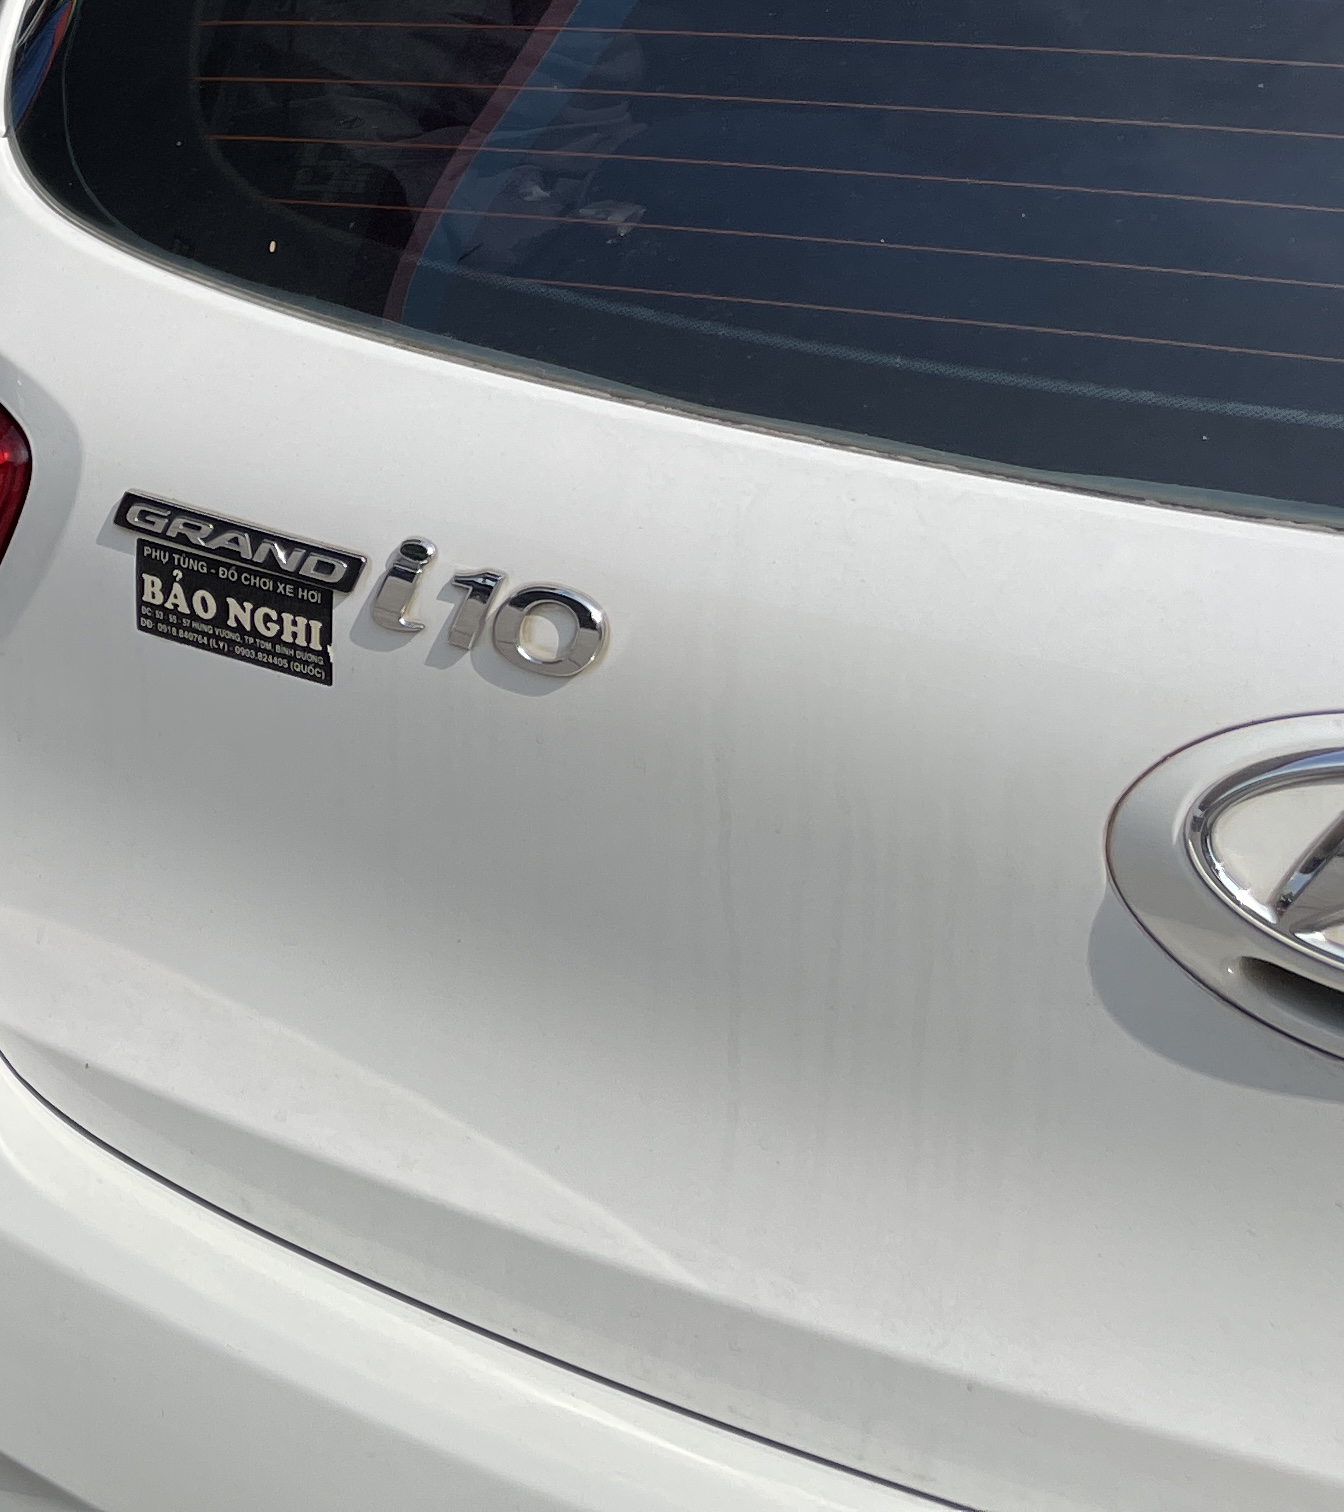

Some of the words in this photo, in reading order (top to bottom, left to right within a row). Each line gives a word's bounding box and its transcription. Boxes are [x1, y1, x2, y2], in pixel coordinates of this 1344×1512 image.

[125, 501, 349, 584] GRAND
[143, 545, 169, 564] PHỤ
[173, 548, 208, 574] TÙNG
[241, 573, 274, 592] CHƠI
[276, 582, 295, 598] XE
[298, 586, 322, 604] HƠI
[141, 569, 218, 620] BẢO
[225, 596, 323, 651] NGHI
